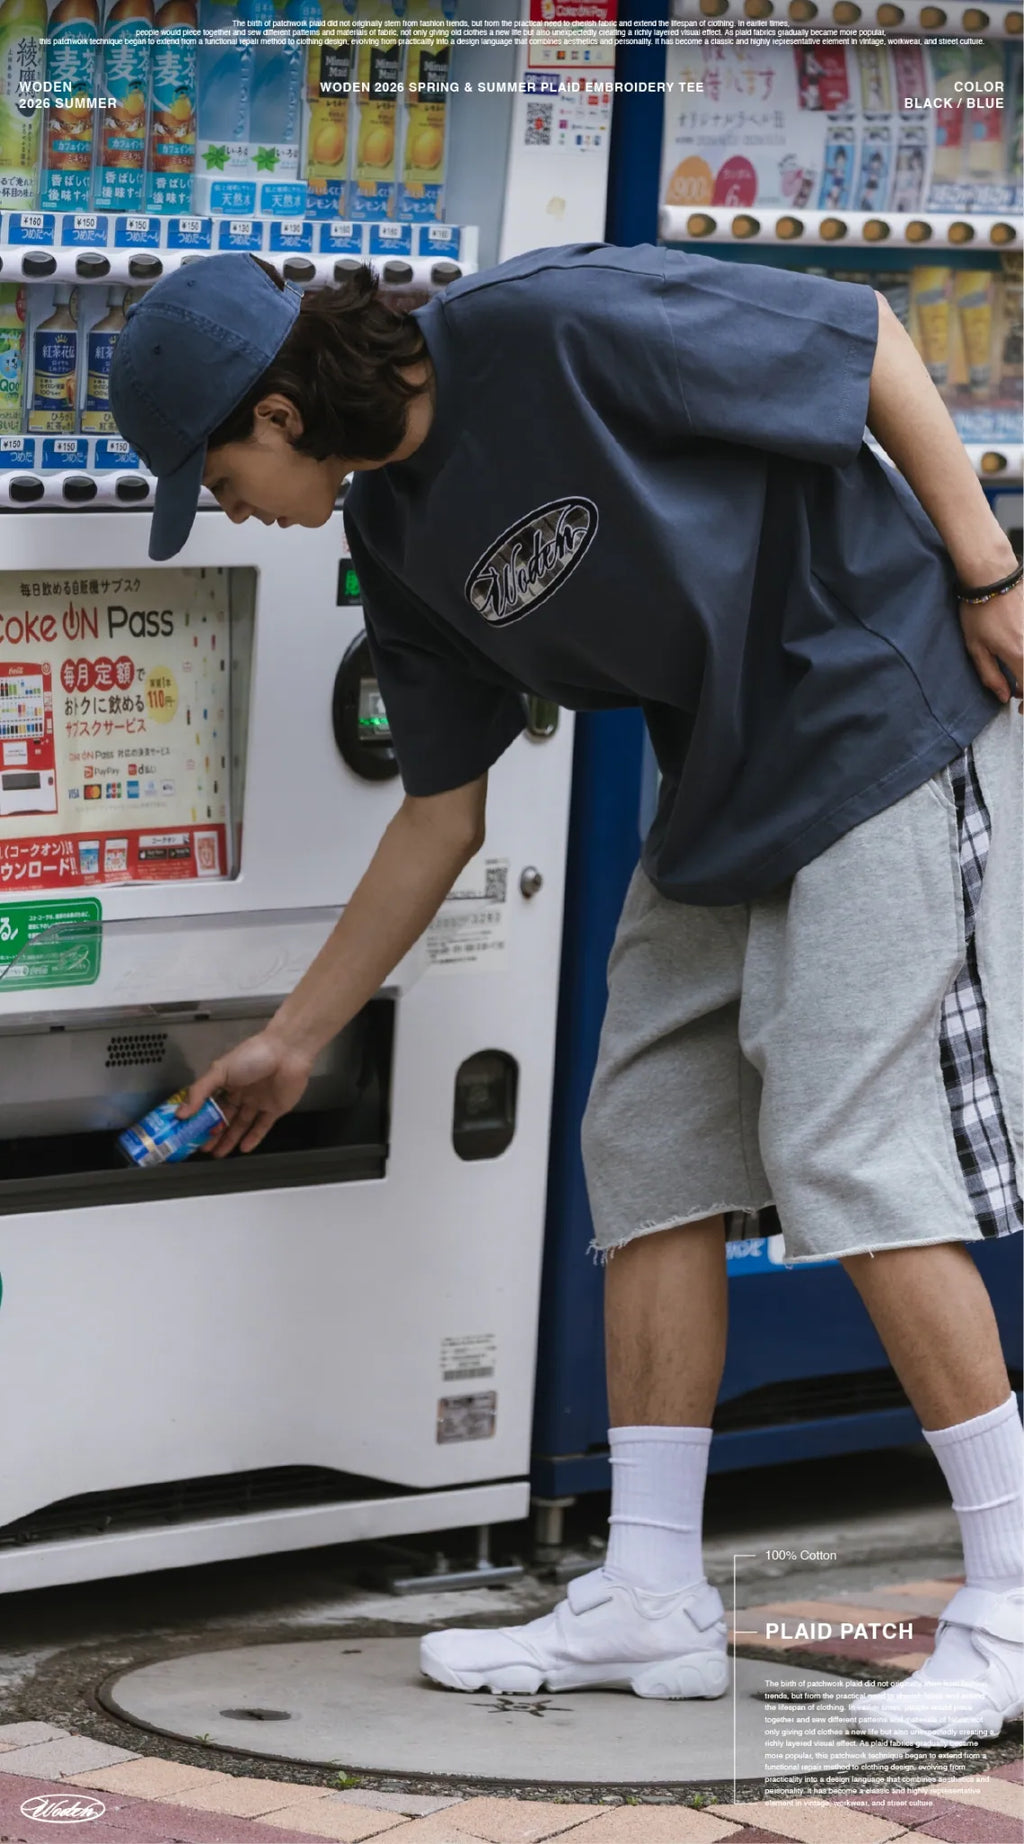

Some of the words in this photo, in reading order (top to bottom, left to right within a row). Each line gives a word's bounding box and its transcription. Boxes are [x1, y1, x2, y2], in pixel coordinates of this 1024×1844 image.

[24, 217, 41, 226] ¥160
[77, 218, 95, 227] ¥150
[129, 220, 147, 229] ¥150
[182, 222, 199, 230] ¥150
[232, 224, 250, 233] ¥130
[58, 442, 75, 451] ¥150
[111, 443, 128, 451] ¥150
[470, 504, 590, 617] Woden
[20, 578, 141, 597] 毎日飲める自販機サブスク
[63, 601, 98, 640] ON
[107, 606, 174, 638] Pass
[64, 662, 146, 688] 毎月定額で
[64, 694, 145, 716] おトクに飲める
[66, 718, 146, 738] サブスクサービス
[94, 768, 120, 776] PayPay
[68, 788, 79, 798] VISA
